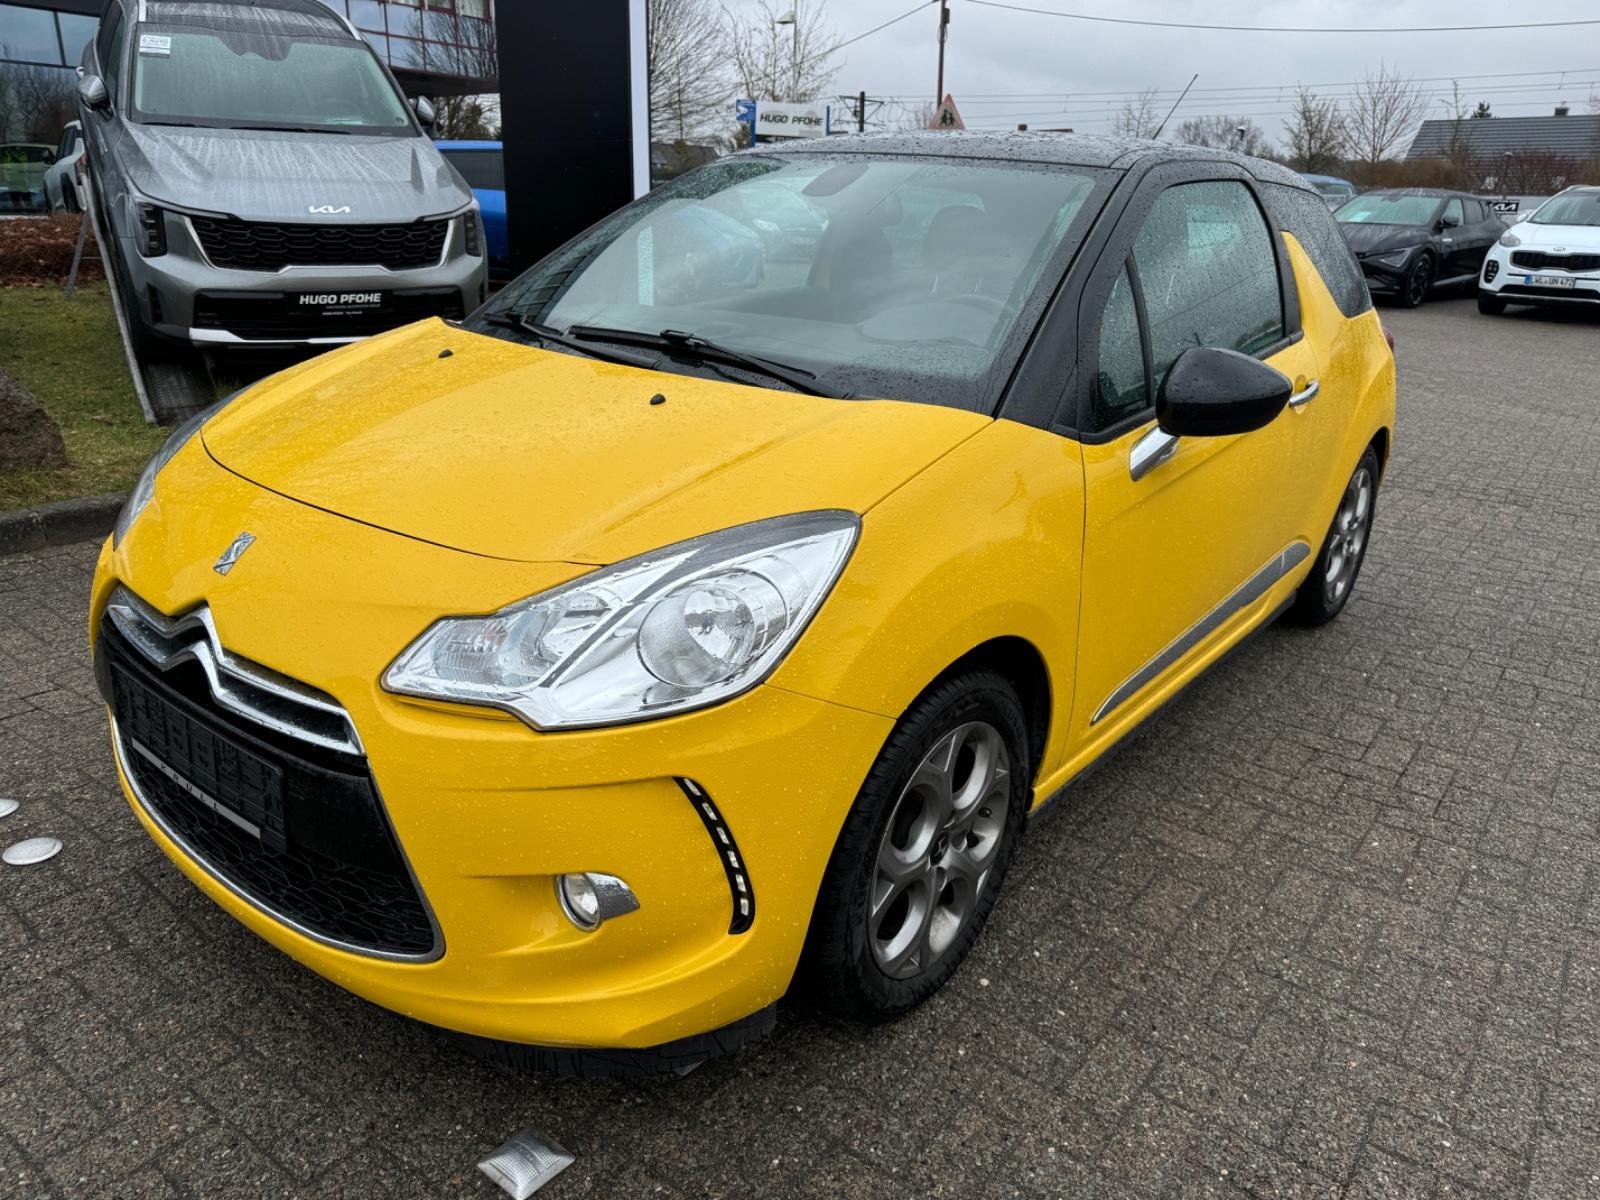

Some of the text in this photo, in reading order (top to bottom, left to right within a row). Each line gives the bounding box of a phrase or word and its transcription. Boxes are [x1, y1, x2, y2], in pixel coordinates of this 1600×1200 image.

[760, 114, 823, 126] HUGO PFOHE
[299, 293, 382, 304] HUGO PFOHE
